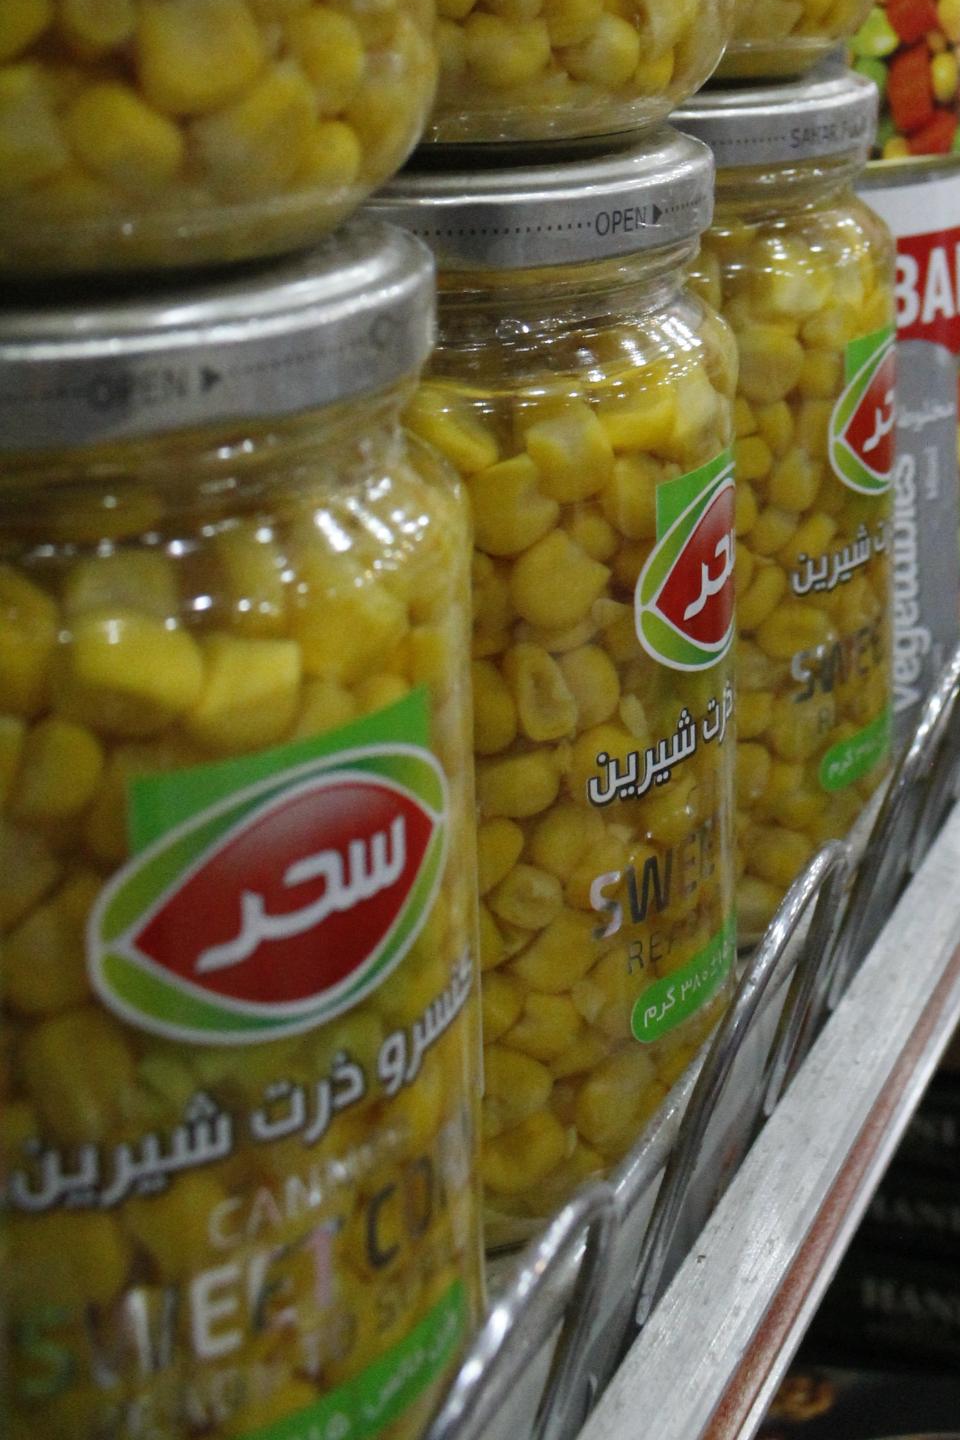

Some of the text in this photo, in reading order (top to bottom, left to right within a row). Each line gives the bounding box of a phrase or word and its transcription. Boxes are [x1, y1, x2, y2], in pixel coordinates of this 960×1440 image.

[595, 205, 647, 237] OPEN
[683, 530, 736, 621] حر
[790, 523, 871, 596] شیرین
[586, 708, 698, 805] شیرین
[195, 813, 408, 976] سحر
[643, 985, 676, 1027] گرم
[250, 1049, 366, 1144] ذرت
[8, 1090, 236, 1212] شیرین
